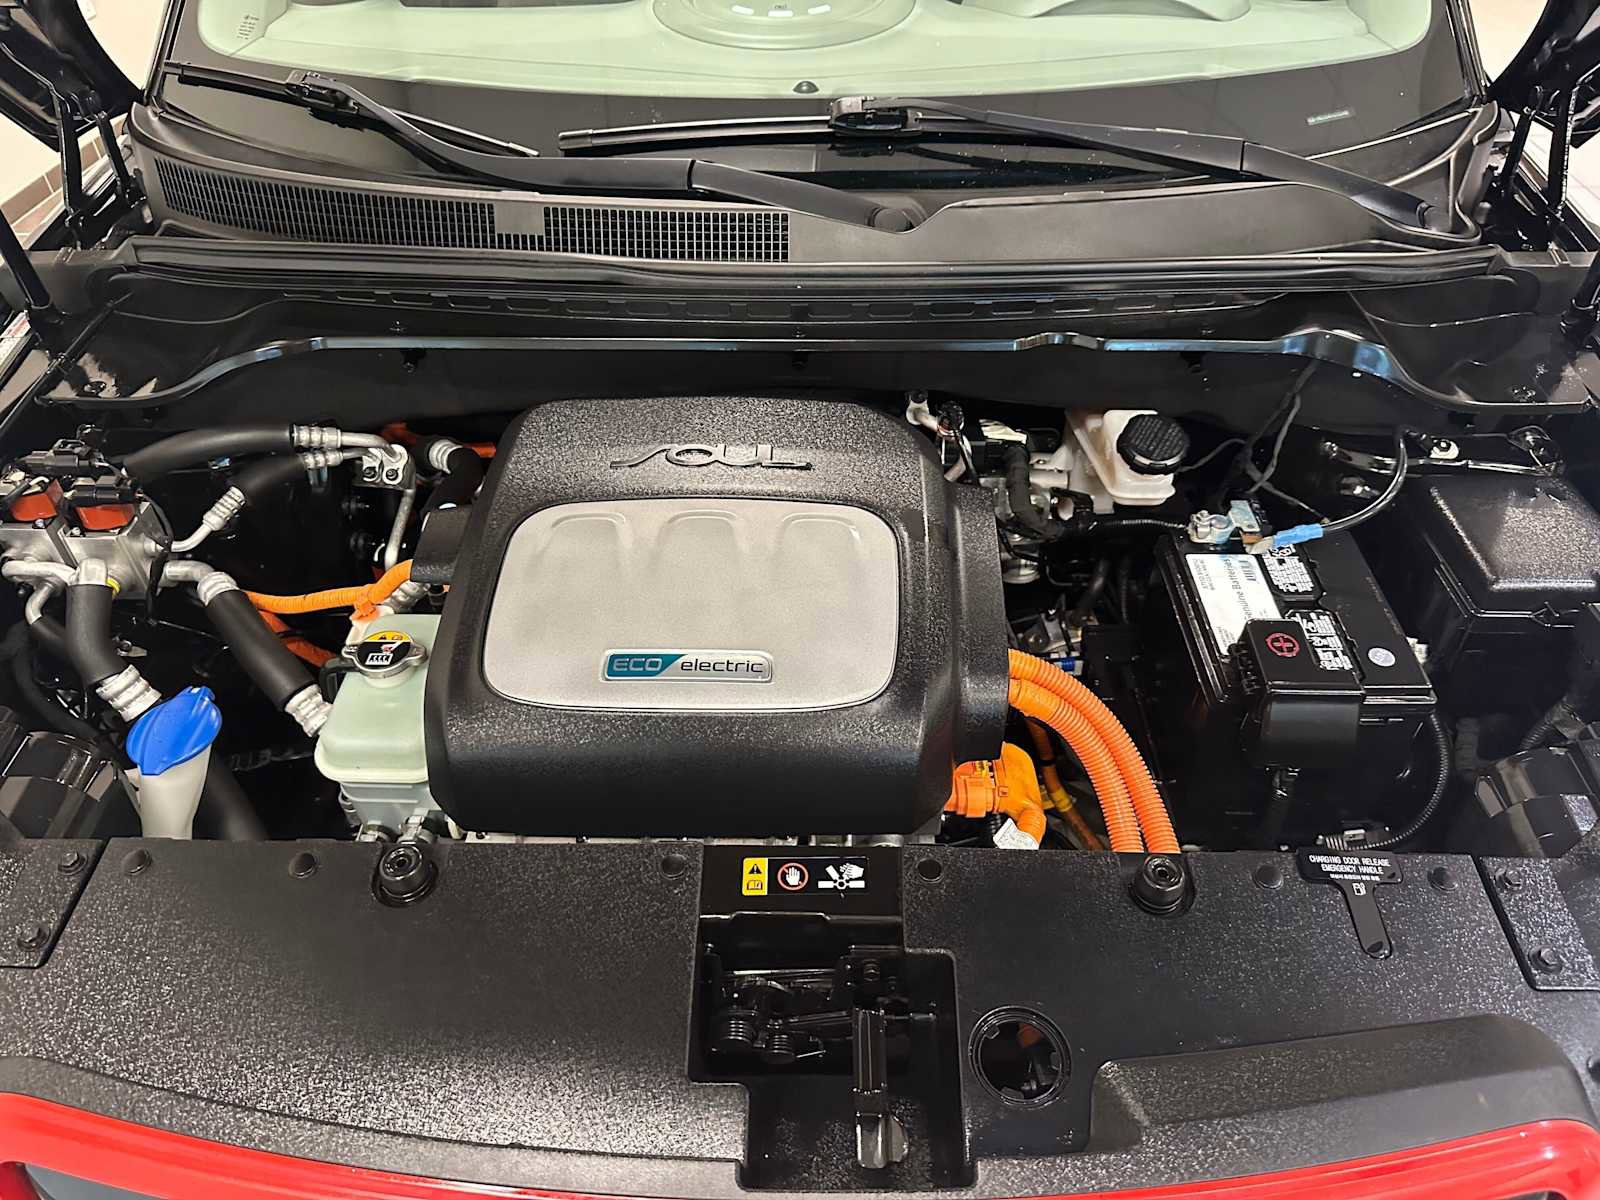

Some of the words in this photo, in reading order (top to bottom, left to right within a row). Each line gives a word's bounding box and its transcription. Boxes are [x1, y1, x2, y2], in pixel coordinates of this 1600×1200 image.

[610, 443, 814, 470] SOUL
[613, 657, 663, 671] ECO
[680, 658, 764, 673] electric
[1309, 855, 1341, 863] CHARGING
[1361, 858, 1390, 867] RELEASE
[1321, 864, 1356, 872] EMERGENCY
[1358, 866, 1384, 874] HANDLE
